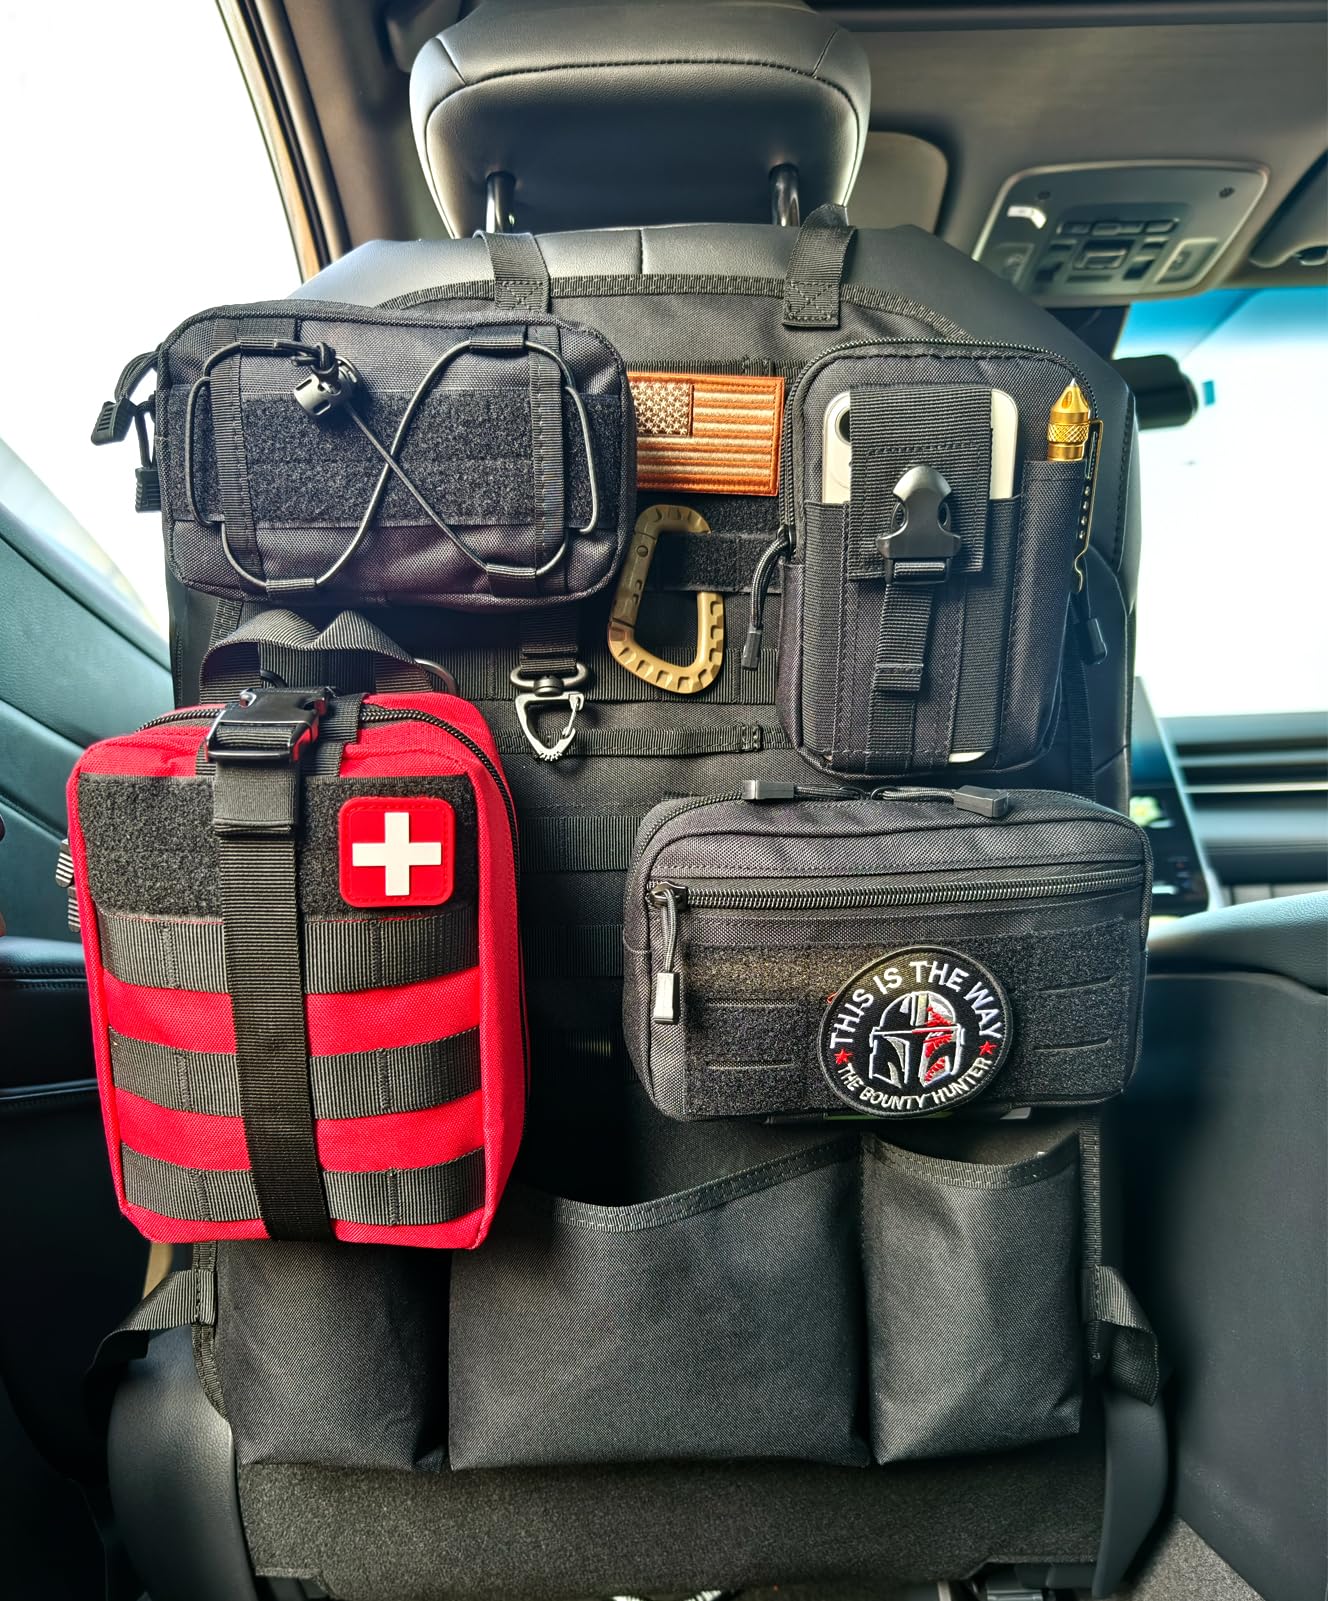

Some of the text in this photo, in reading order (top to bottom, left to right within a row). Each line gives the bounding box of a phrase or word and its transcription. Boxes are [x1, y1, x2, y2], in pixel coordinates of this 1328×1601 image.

[830, 960, 1003, 1049] THIS IS THE WAY
[837, 1056, 993, 1110] THE BOUNTY HUNTER
